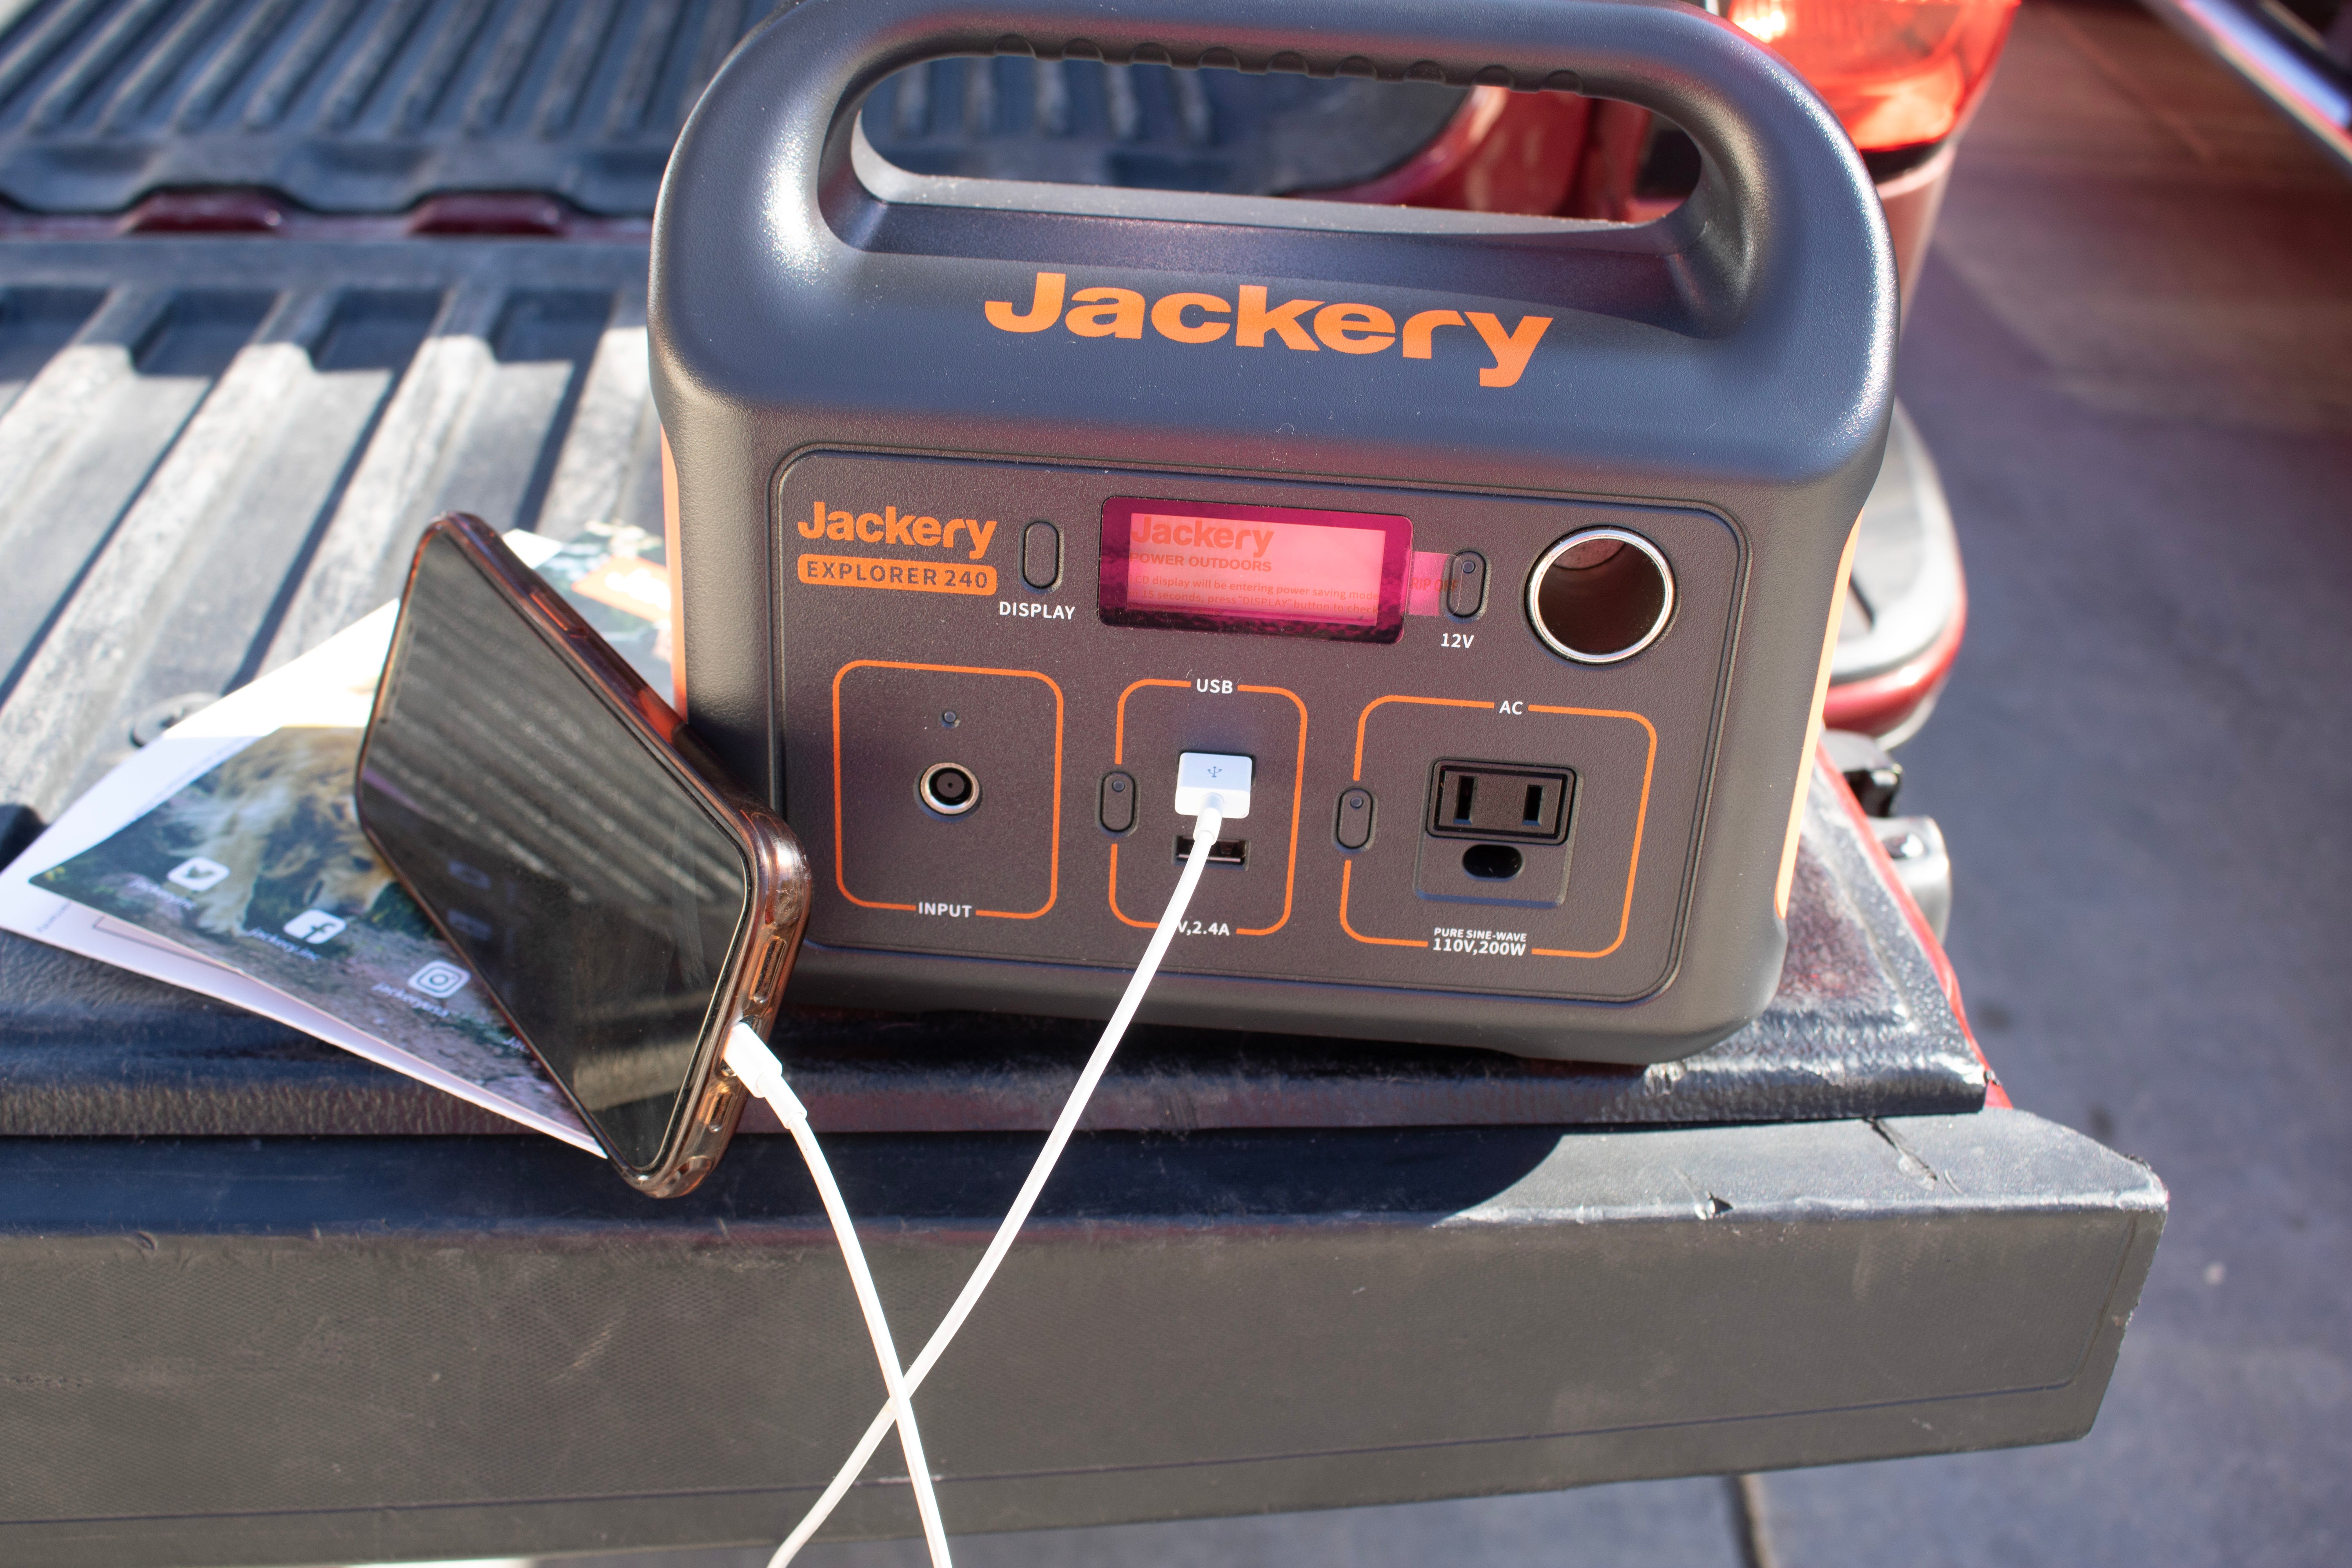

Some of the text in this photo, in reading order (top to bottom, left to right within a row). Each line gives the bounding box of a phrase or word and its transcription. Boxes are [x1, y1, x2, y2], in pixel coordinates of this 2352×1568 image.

[984, 272, 1553, 388] Jackery
[797, 501, 998, 559] Jackery
[1131, 516, 1275, 558] Jackery
[1129, 552, 1272, 572] POWER OUTDOORS
[806, 560, 988, 588] EXPLORER 240
[1129, 575, 1380, 601] LCD display will be entering power saving mode
[1410, 577, 1459, 594] RIP OFF
[999, 601, 1076, 620] DISPLAY
[1143, 590, 1155, 599] 15
[1157, 592, 1204, 603] seconds,
[1207, 595, 1236, 604] press
[1293, 599, 1330, 611] button
[1333, 603, 1344, 612] to
[1347, 604, 1379, 615] check
[1441, 633, 1474, 649] 12V
[1196, 677, 1234, 695] USB
[1499, 700, 1523, 715] AC
[918, 901, 973, 919] INPUT
[1178, 920, 1230, 936] V,2.4A
[1433, 927, 1527, 942] PURE SINE-WAVE
[1432, 937, 1527, 956] 110V,200W
